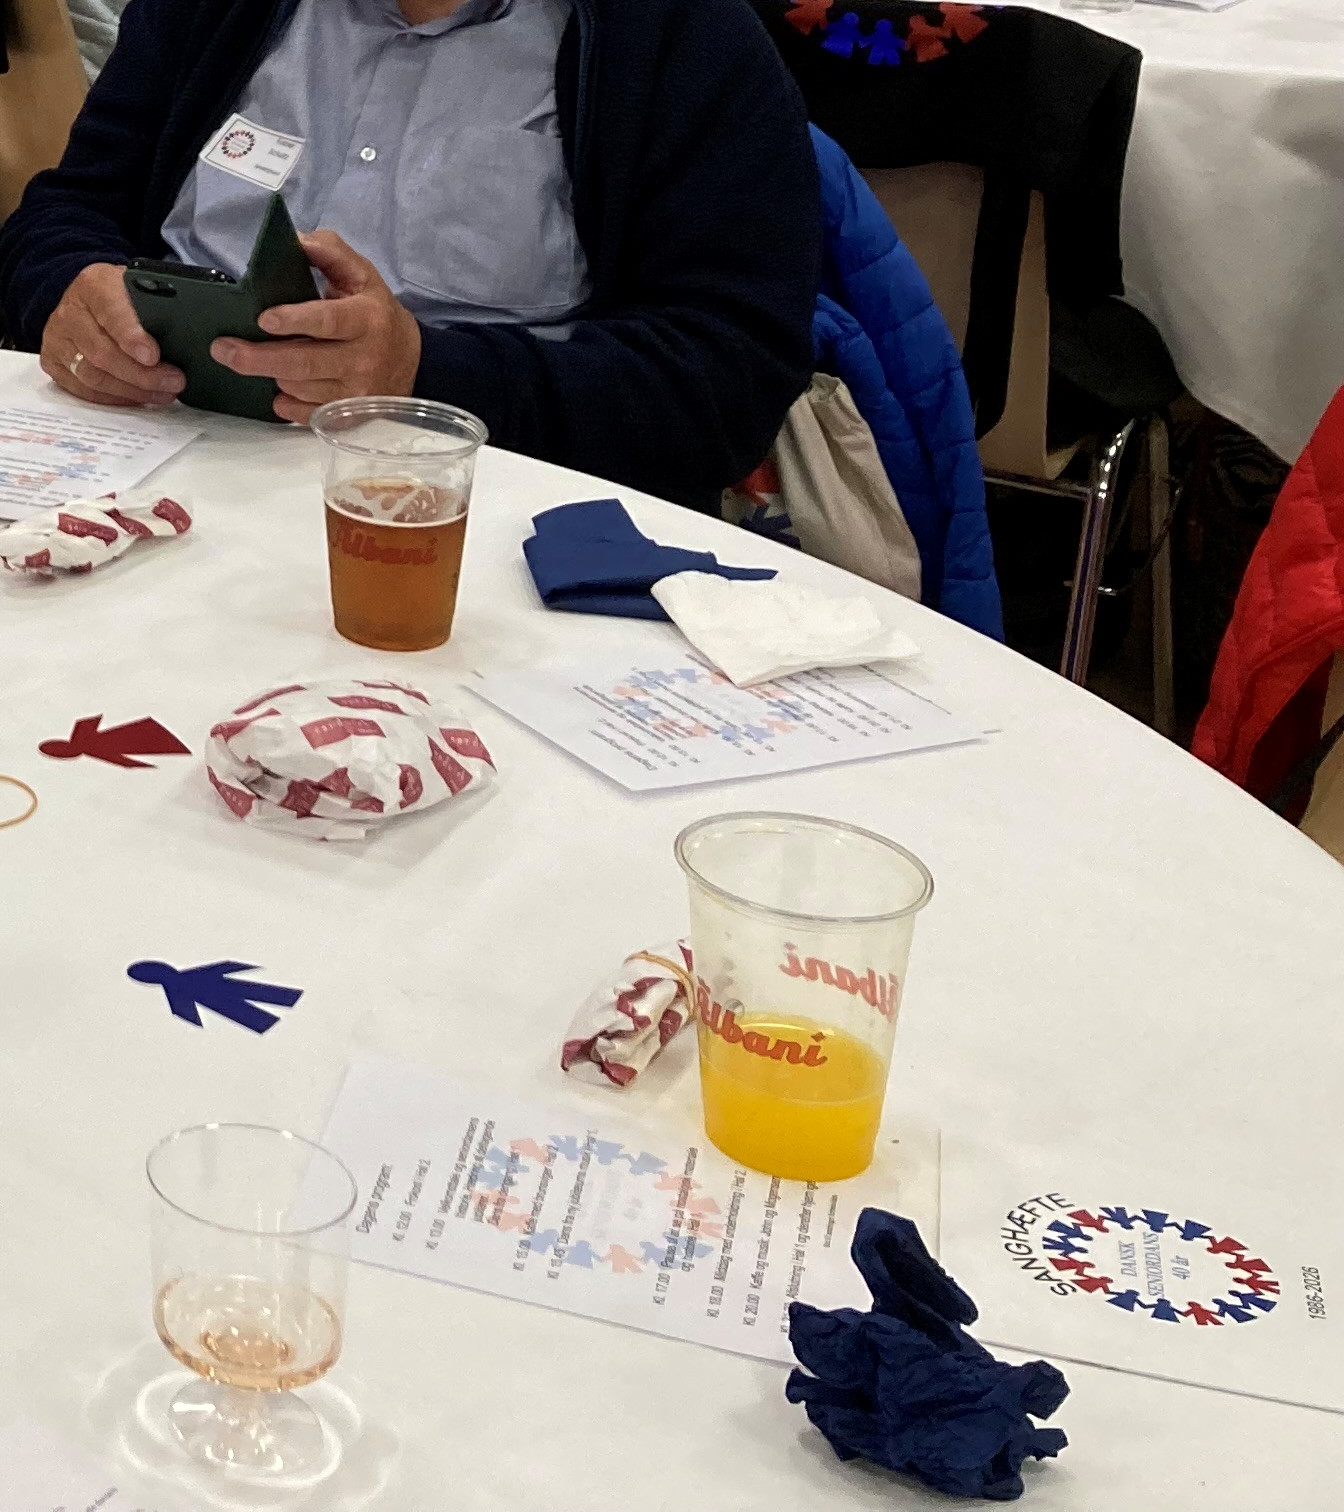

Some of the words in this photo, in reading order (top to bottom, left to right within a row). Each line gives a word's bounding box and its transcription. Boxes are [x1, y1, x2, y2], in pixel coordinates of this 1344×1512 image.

[332, 519, 439, 566] Albani
[696, 975, 829, 1068] Albani
[1000, 1192, 1076, 1298] SANGHÆFTE
[1118, 1240, 1138, 1278] DANSK
[1142, 1231, 1164, 1300] SENIORDANS
[1172, 1265, 1191, 1281] 40
[1300, 1265, 1328, 1322] 1986-2026
